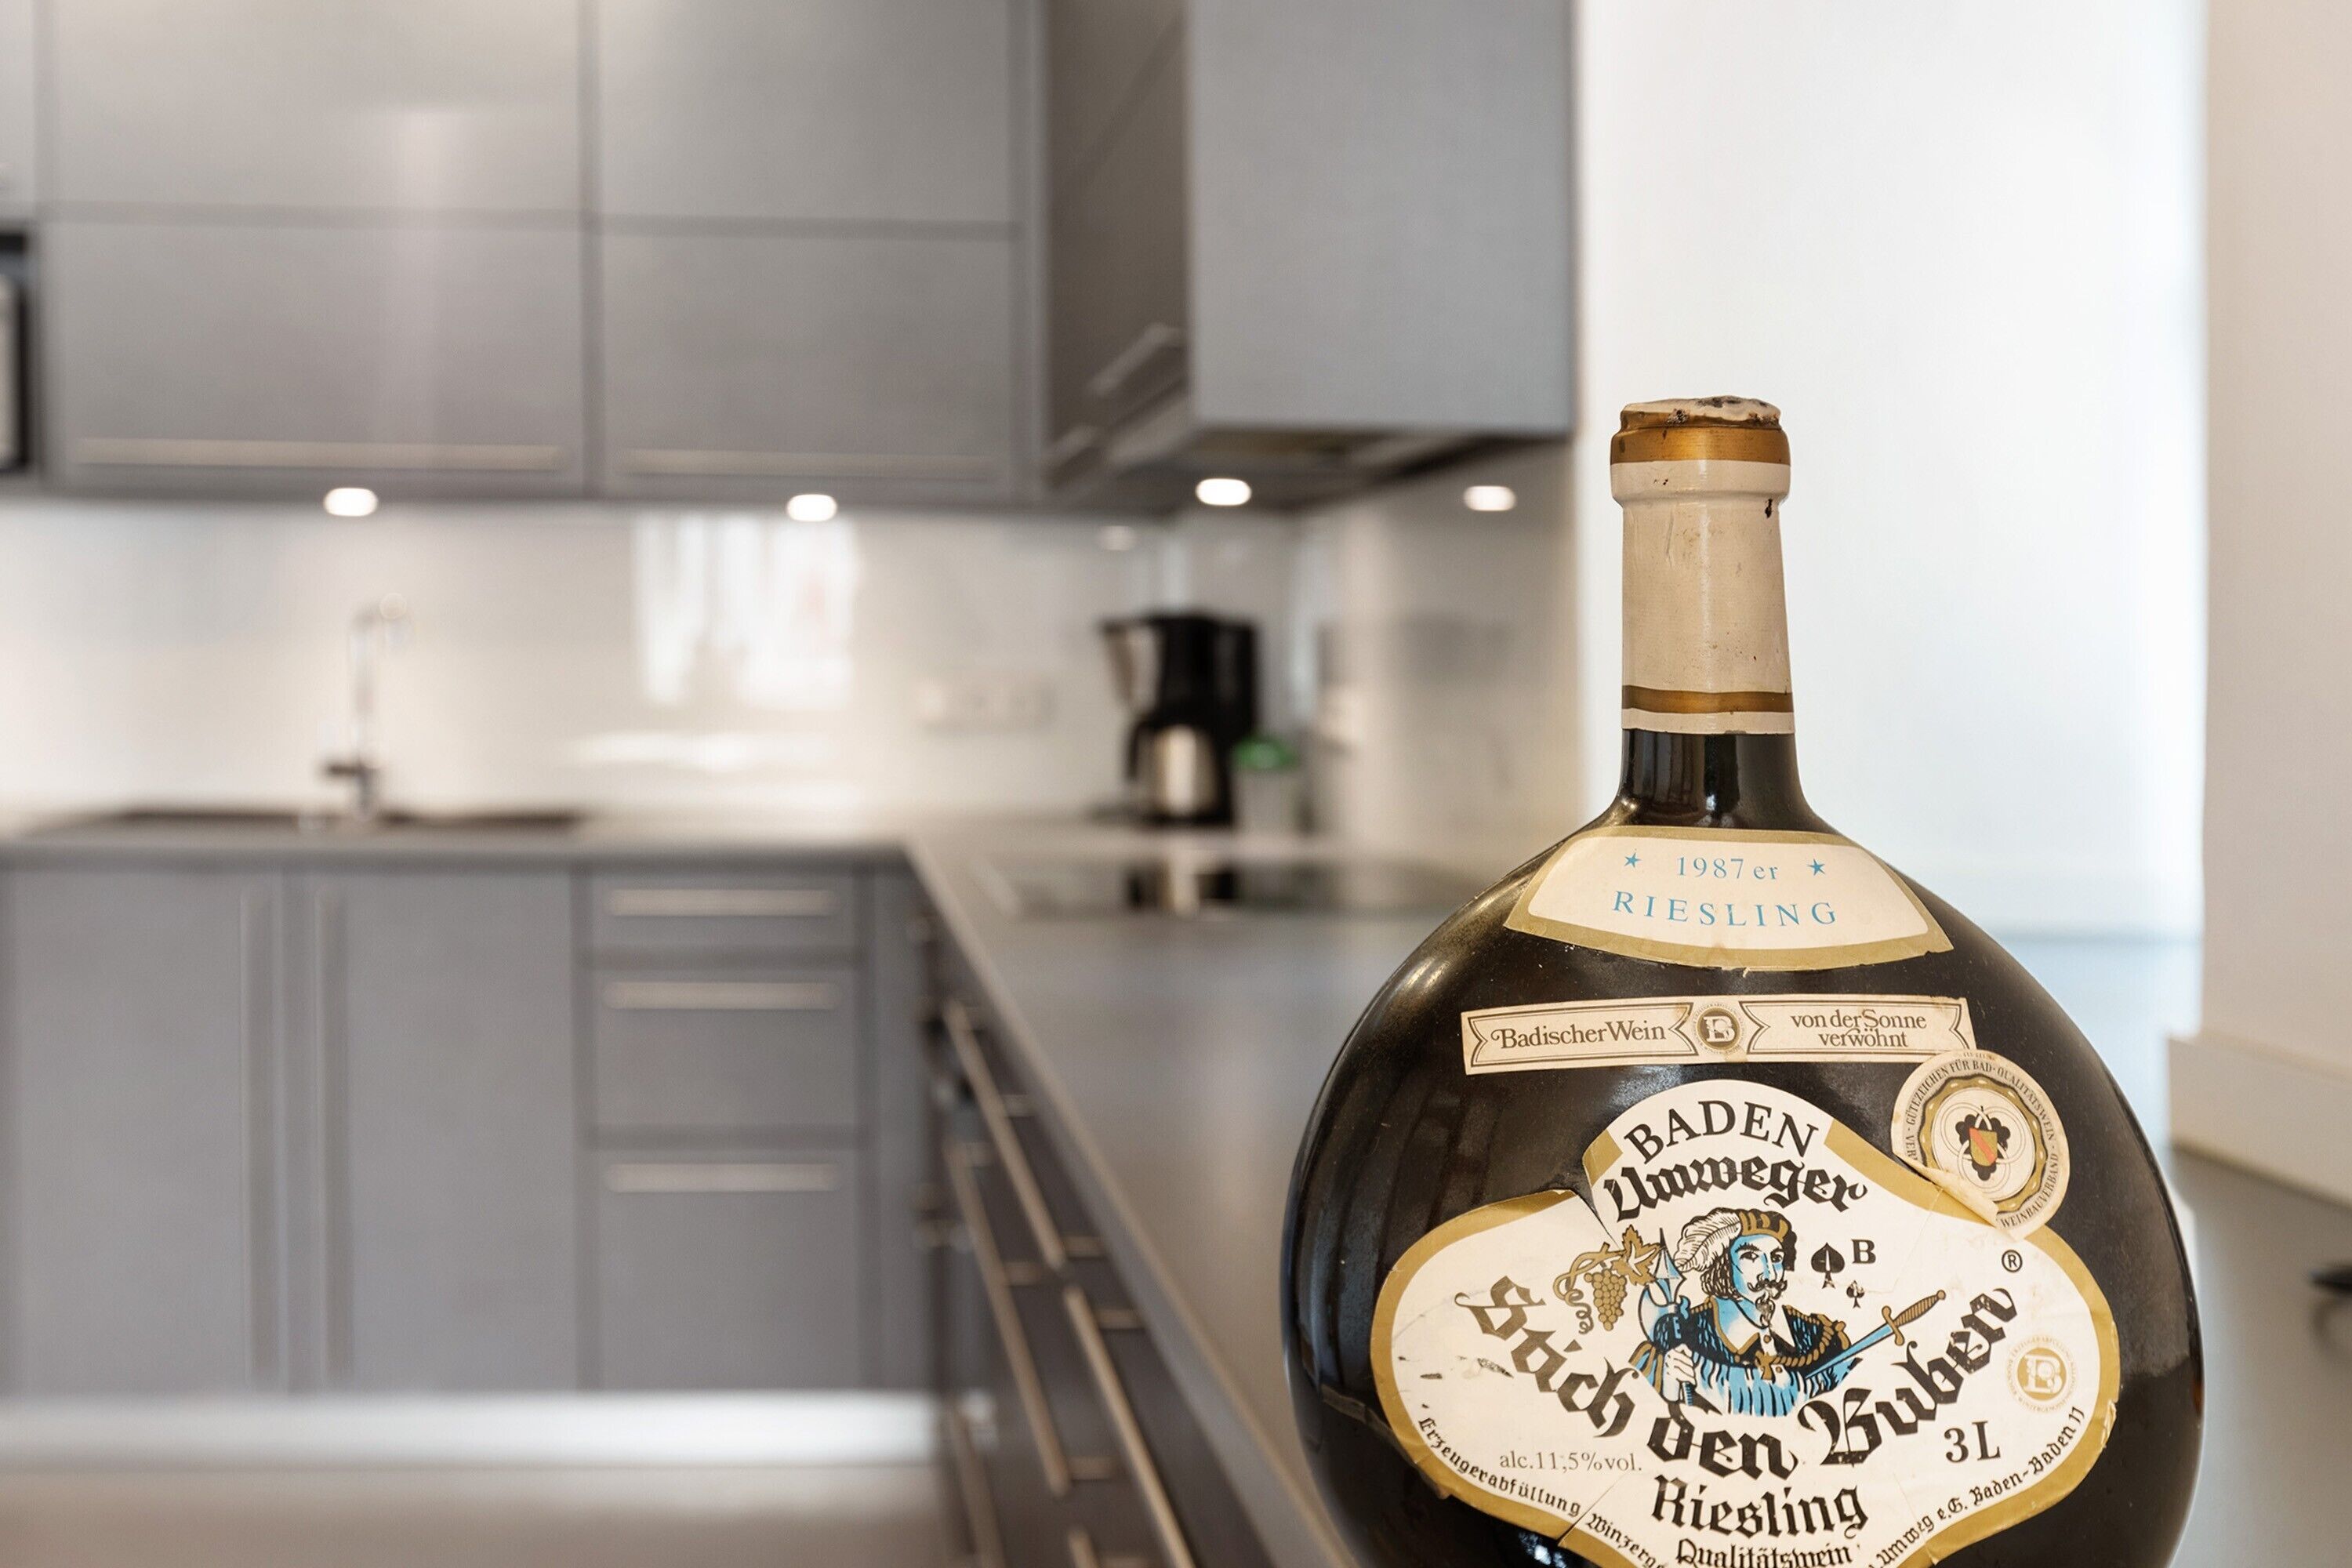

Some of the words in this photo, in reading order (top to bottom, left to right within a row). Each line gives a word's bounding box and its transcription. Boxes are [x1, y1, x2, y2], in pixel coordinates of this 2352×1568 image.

[1611, 890, 1837, 927] RIESLING
[1790, 1014, 1828, 1028] von
[1818, 1028, 1909, 1047] verwöhnt
[1623, 1099, 1820, 1165] BADEN
[1905, 1066, 1950, 1125] GÜTEZEICHEN
[1949, 1058, 1970, 1073] FÜR
[1996, 1065, 2056, 1142] QUALITÄTSWEIN
[1603, 1155, 1869, 1223] Umweger
[2000, 1152, 2059, 1229] WEINBAUVERBAND
[1851, 1238, 1877, 1265] B
[1454, 1275, 1640, 1439] Stich
[1646, 1391, 1799, 1480] den
[1798, 1287, 2018, 1467] Buben
[1418, 1416, 1581, 1518] Erzeugerabfüllung
[1586, 1512, 1668, 1568] Winzerg
[1969, 1425, 2077, 1507] Baden-Baden
[1651, 1473, 1869, 1540] Riesling
[1675, 1537, 1853, 1568] Qualitätswein
